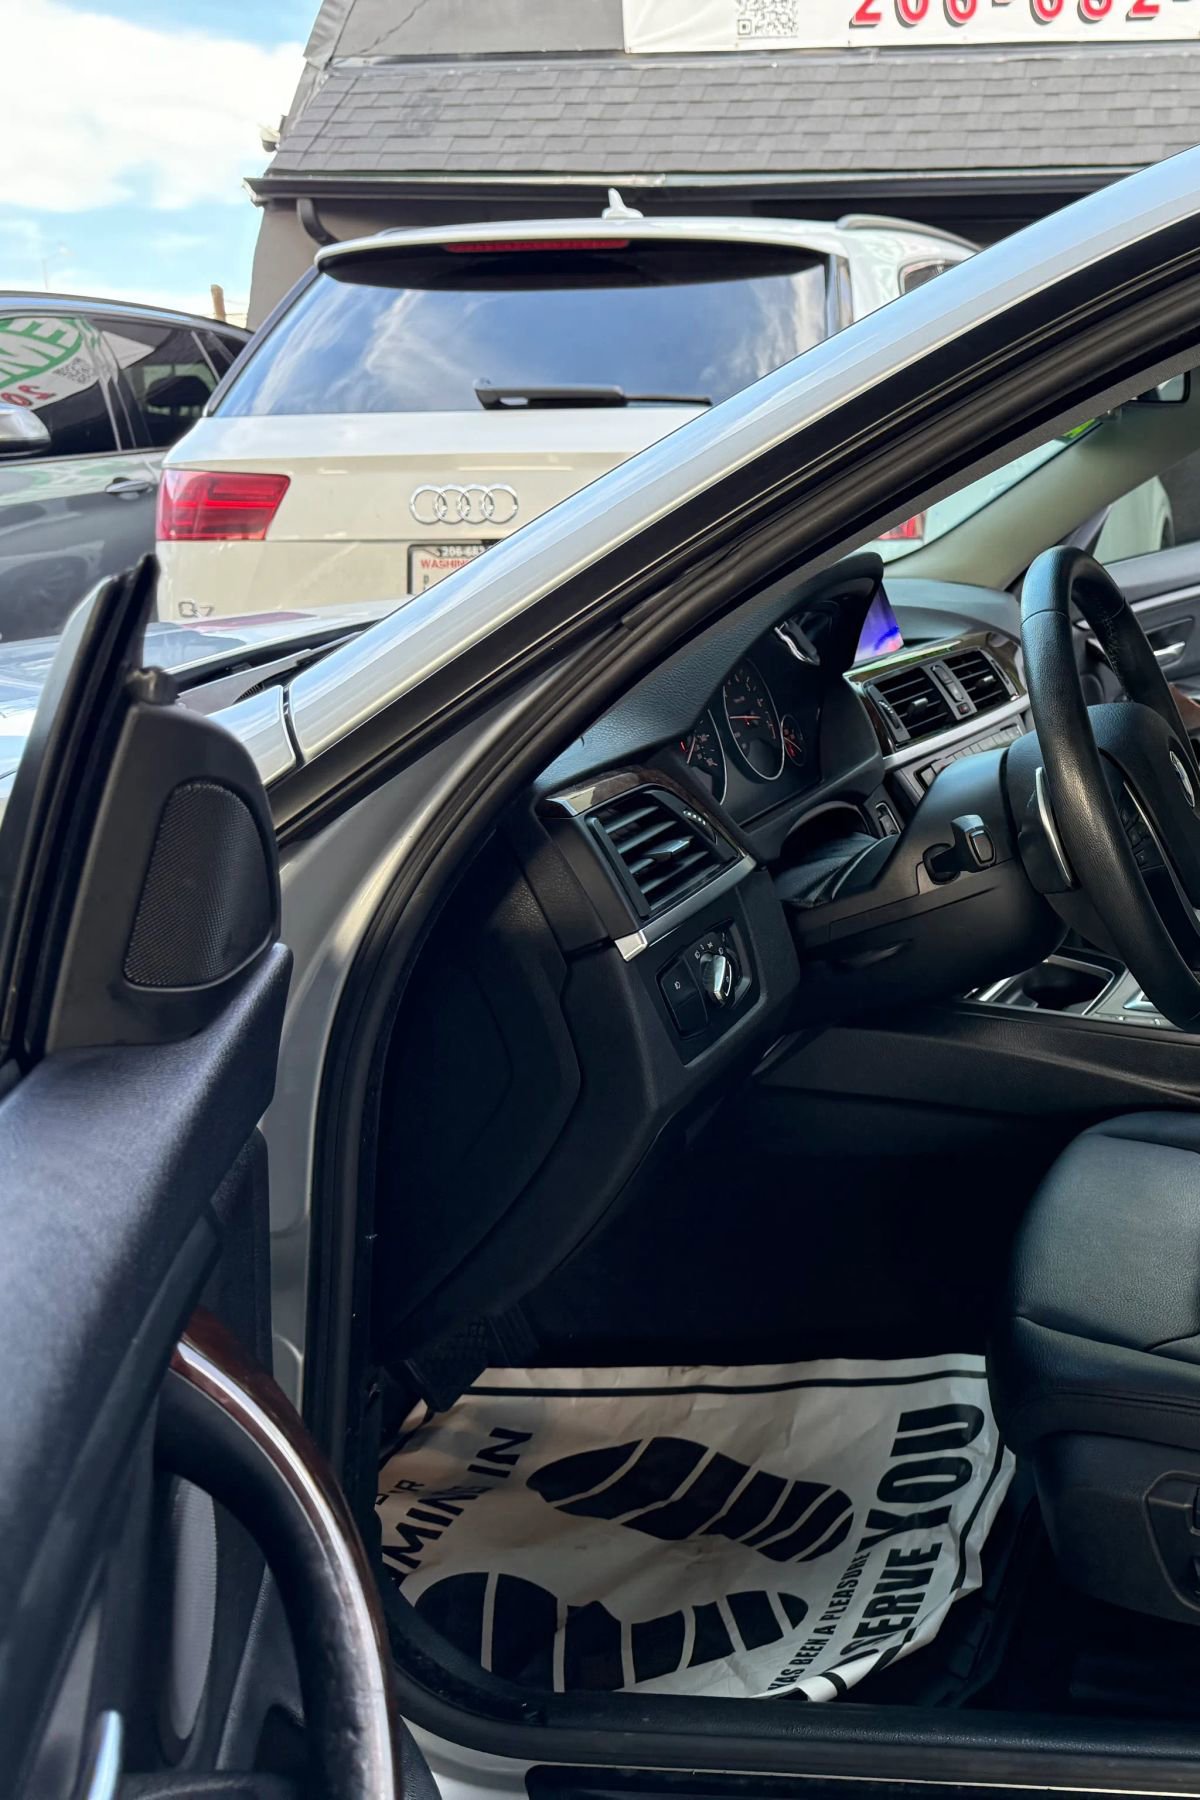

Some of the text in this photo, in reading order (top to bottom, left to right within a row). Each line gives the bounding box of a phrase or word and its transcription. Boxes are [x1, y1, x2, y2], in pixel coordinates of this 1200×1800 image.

[857, 1403, 985, 1553] YOU
[820, 1551, 871, 1622] PLEASURE
[797, 1636, 829, 1667] BEEN
[821, 1624, 836, 1636] A
